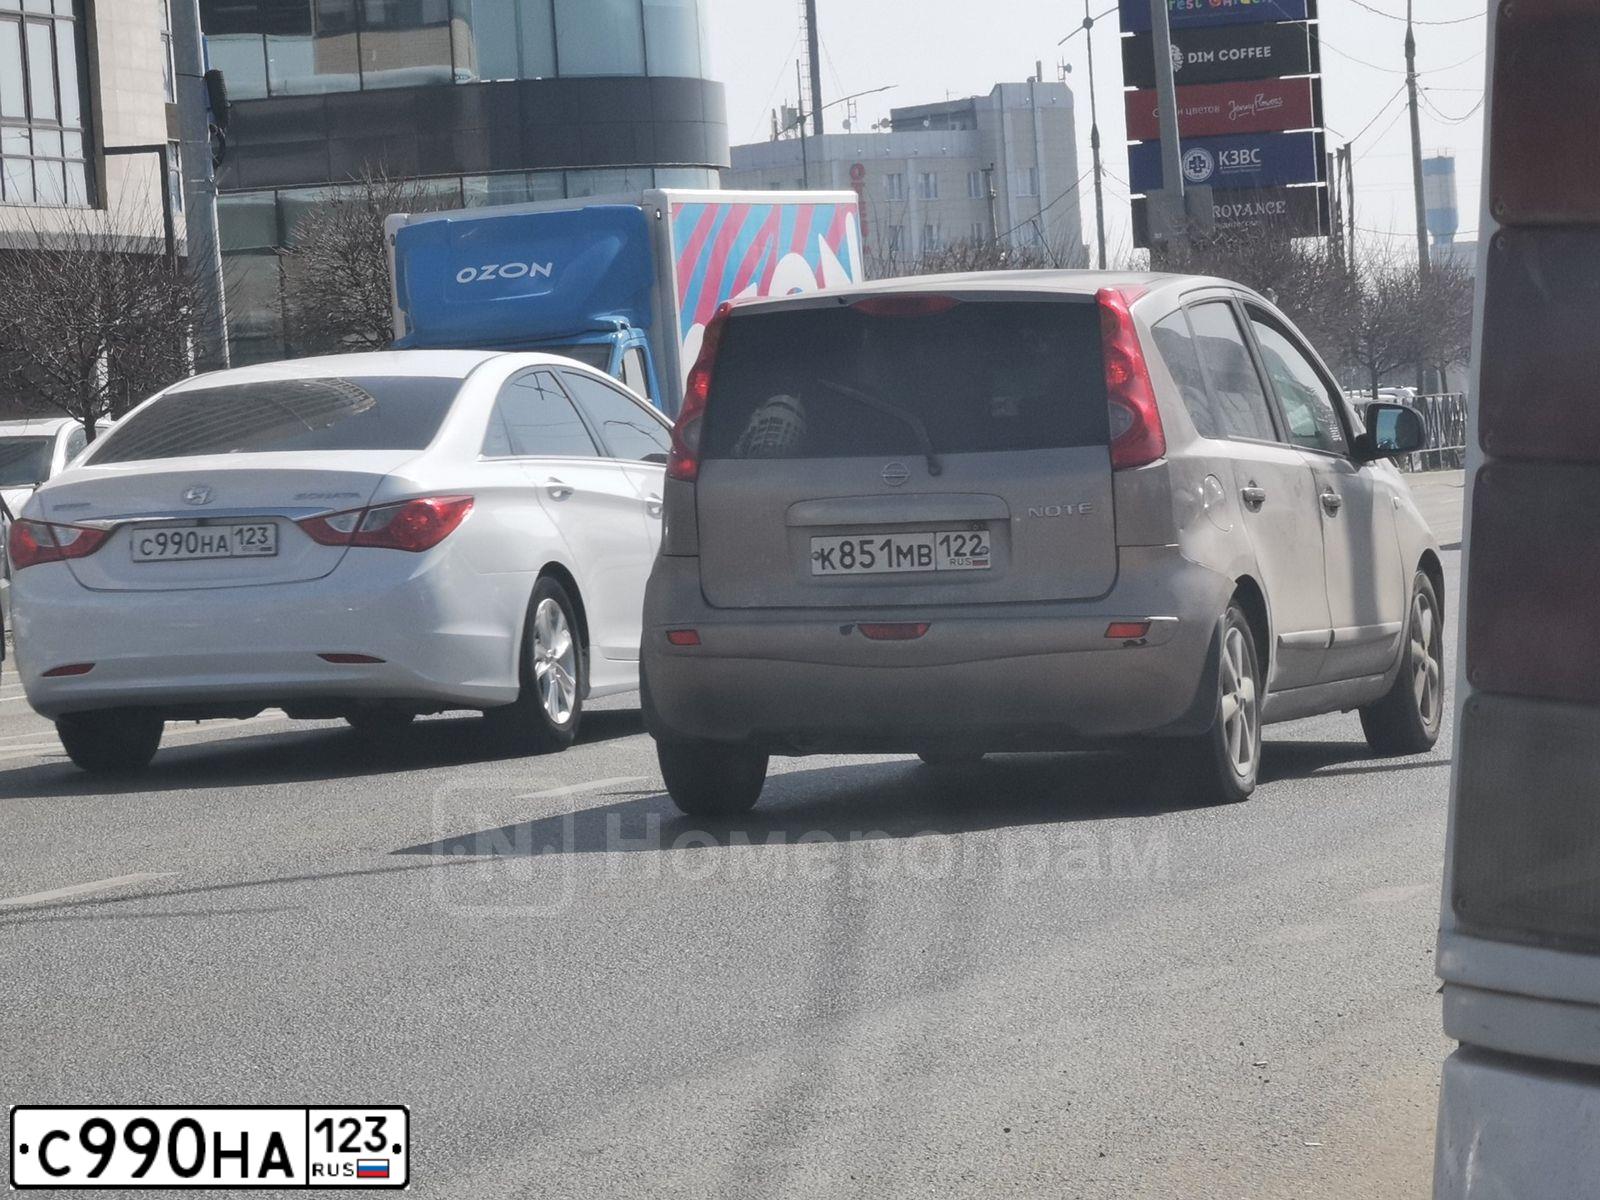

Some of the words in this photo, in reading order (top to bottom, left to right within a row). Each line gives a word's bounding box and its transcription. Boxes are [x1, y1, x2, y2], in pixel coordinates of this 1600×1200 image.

[1188, 50, 1214, 64] DIM
[1218, 46, 1272, 61] COFFEE
[1212, 200, 1286, 218] ROVANCE
[456, 261, 554, 285] OZON
[1028, 501, 1094, 518] NOTE
[139, 530, 229, 557] С990НА
[234, 526, 269, 546] 123
[819, 538, 933, 571] К851МВ
[938, 533, 983, 558] 122
[949, 557, 972, 567] RUS
